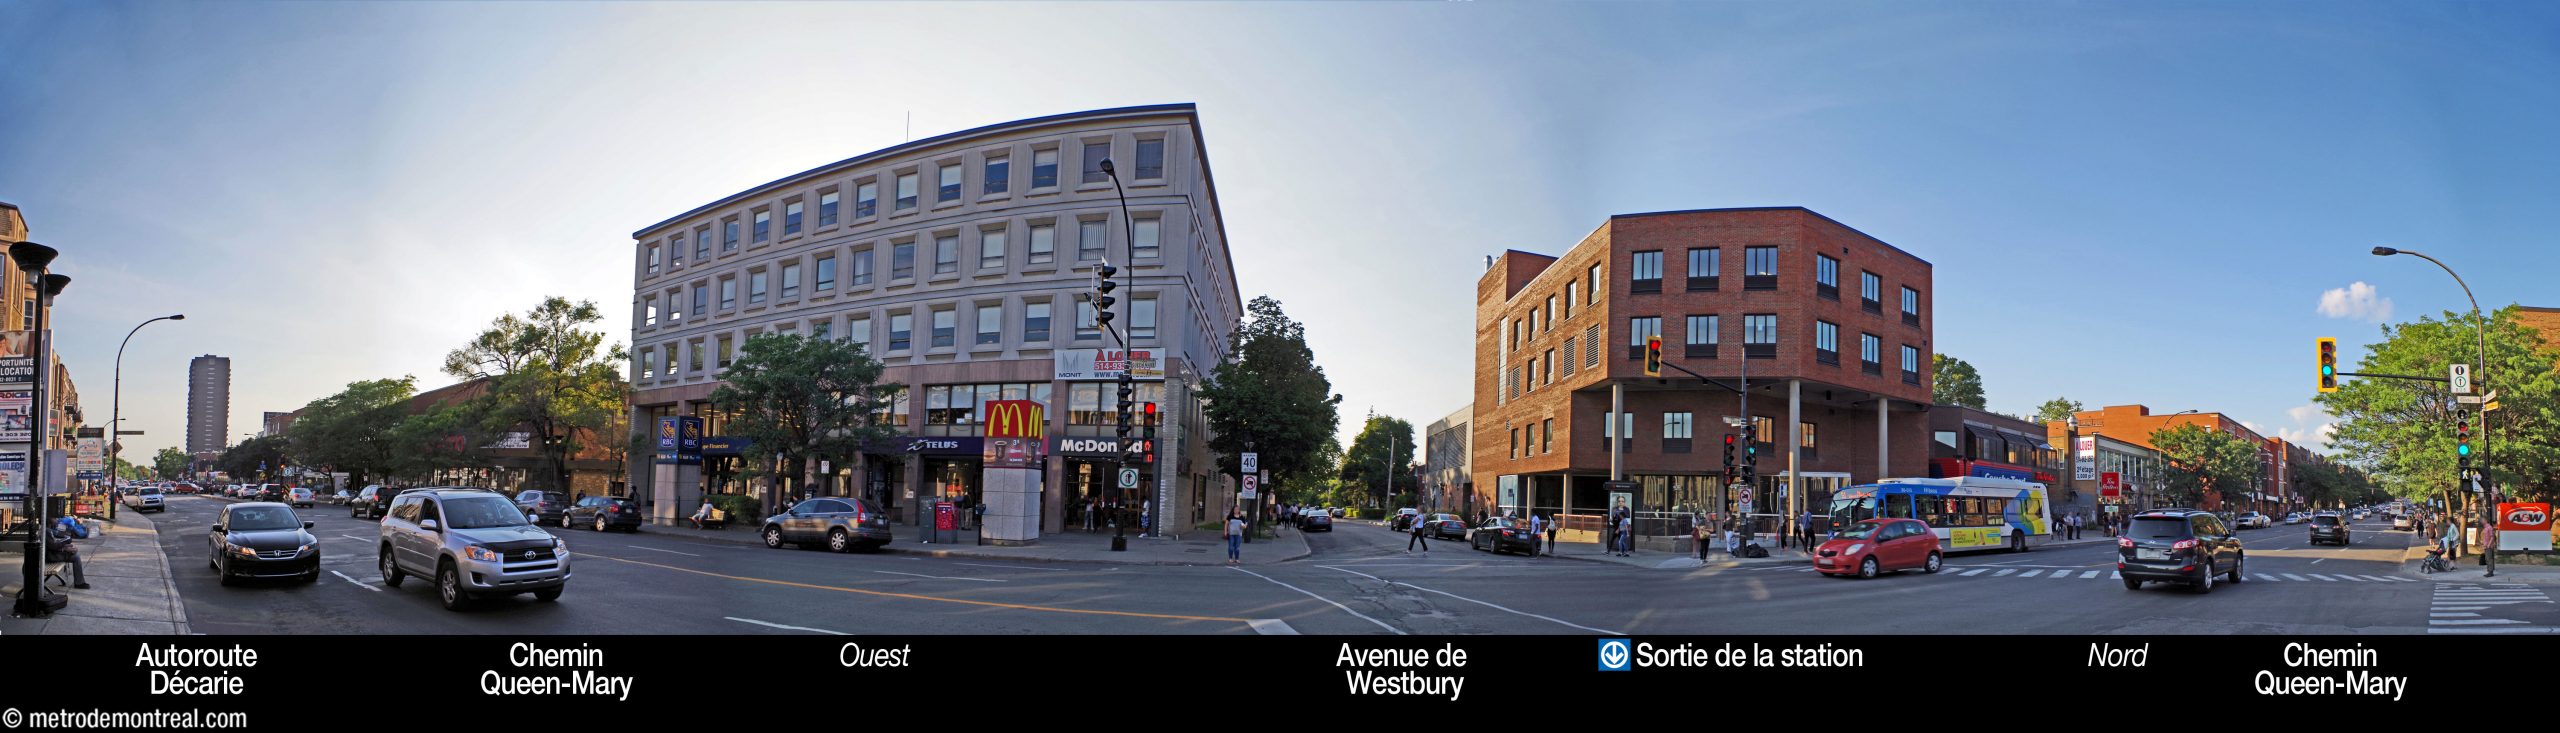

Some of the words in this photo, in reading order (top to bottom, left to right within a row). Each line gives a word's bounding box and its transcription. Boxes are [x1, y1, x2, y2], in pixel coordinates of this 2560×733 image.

[1095, 347, 1106, 361] À
[0, 367, 34, 376] LOCATIO
[925, 440, 958, 449] TELUS
[1243, 457, 1256, 468] 40
[2511, 513, 2544, 523] A&W
